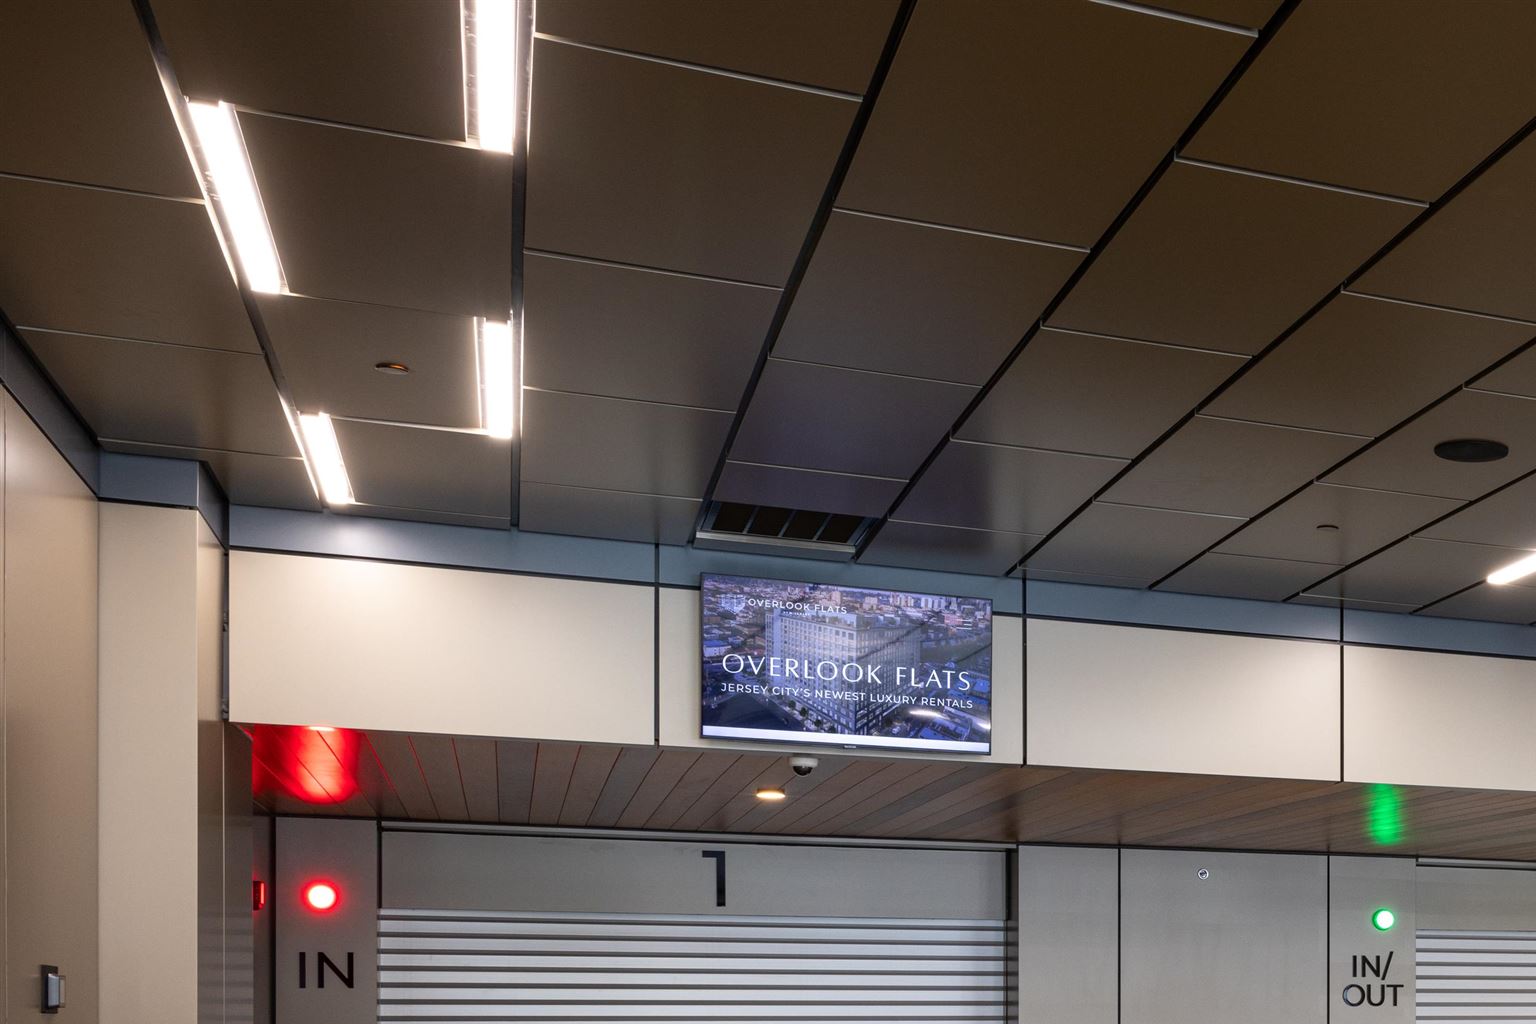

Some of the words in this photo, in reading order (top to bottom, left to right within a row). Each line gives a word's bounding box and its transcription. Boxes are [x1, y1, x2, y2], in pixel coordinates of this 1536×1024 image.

[747, 598, 810, 611] OVERLOOK
[814, 604, 848, 614] FLATS
[722, 653, 882, 684] OVERLOOK
[896, 666, 971, 691] FLATS
[720, 682, 768, 695] JERSEY
[772, 686, 810, 698] CITY'S
[815, 690, 866, 701] NEWEST
[870, 693, 917, 705] LUXURY
[921, 697, 973, 709] RENTALS
[702, 850, 726, 907] 1
[299, 951, 355, 989] IN
[1352, 951, 1394, 981] IN/
[1342, 983, 1404, 1007] OUT
